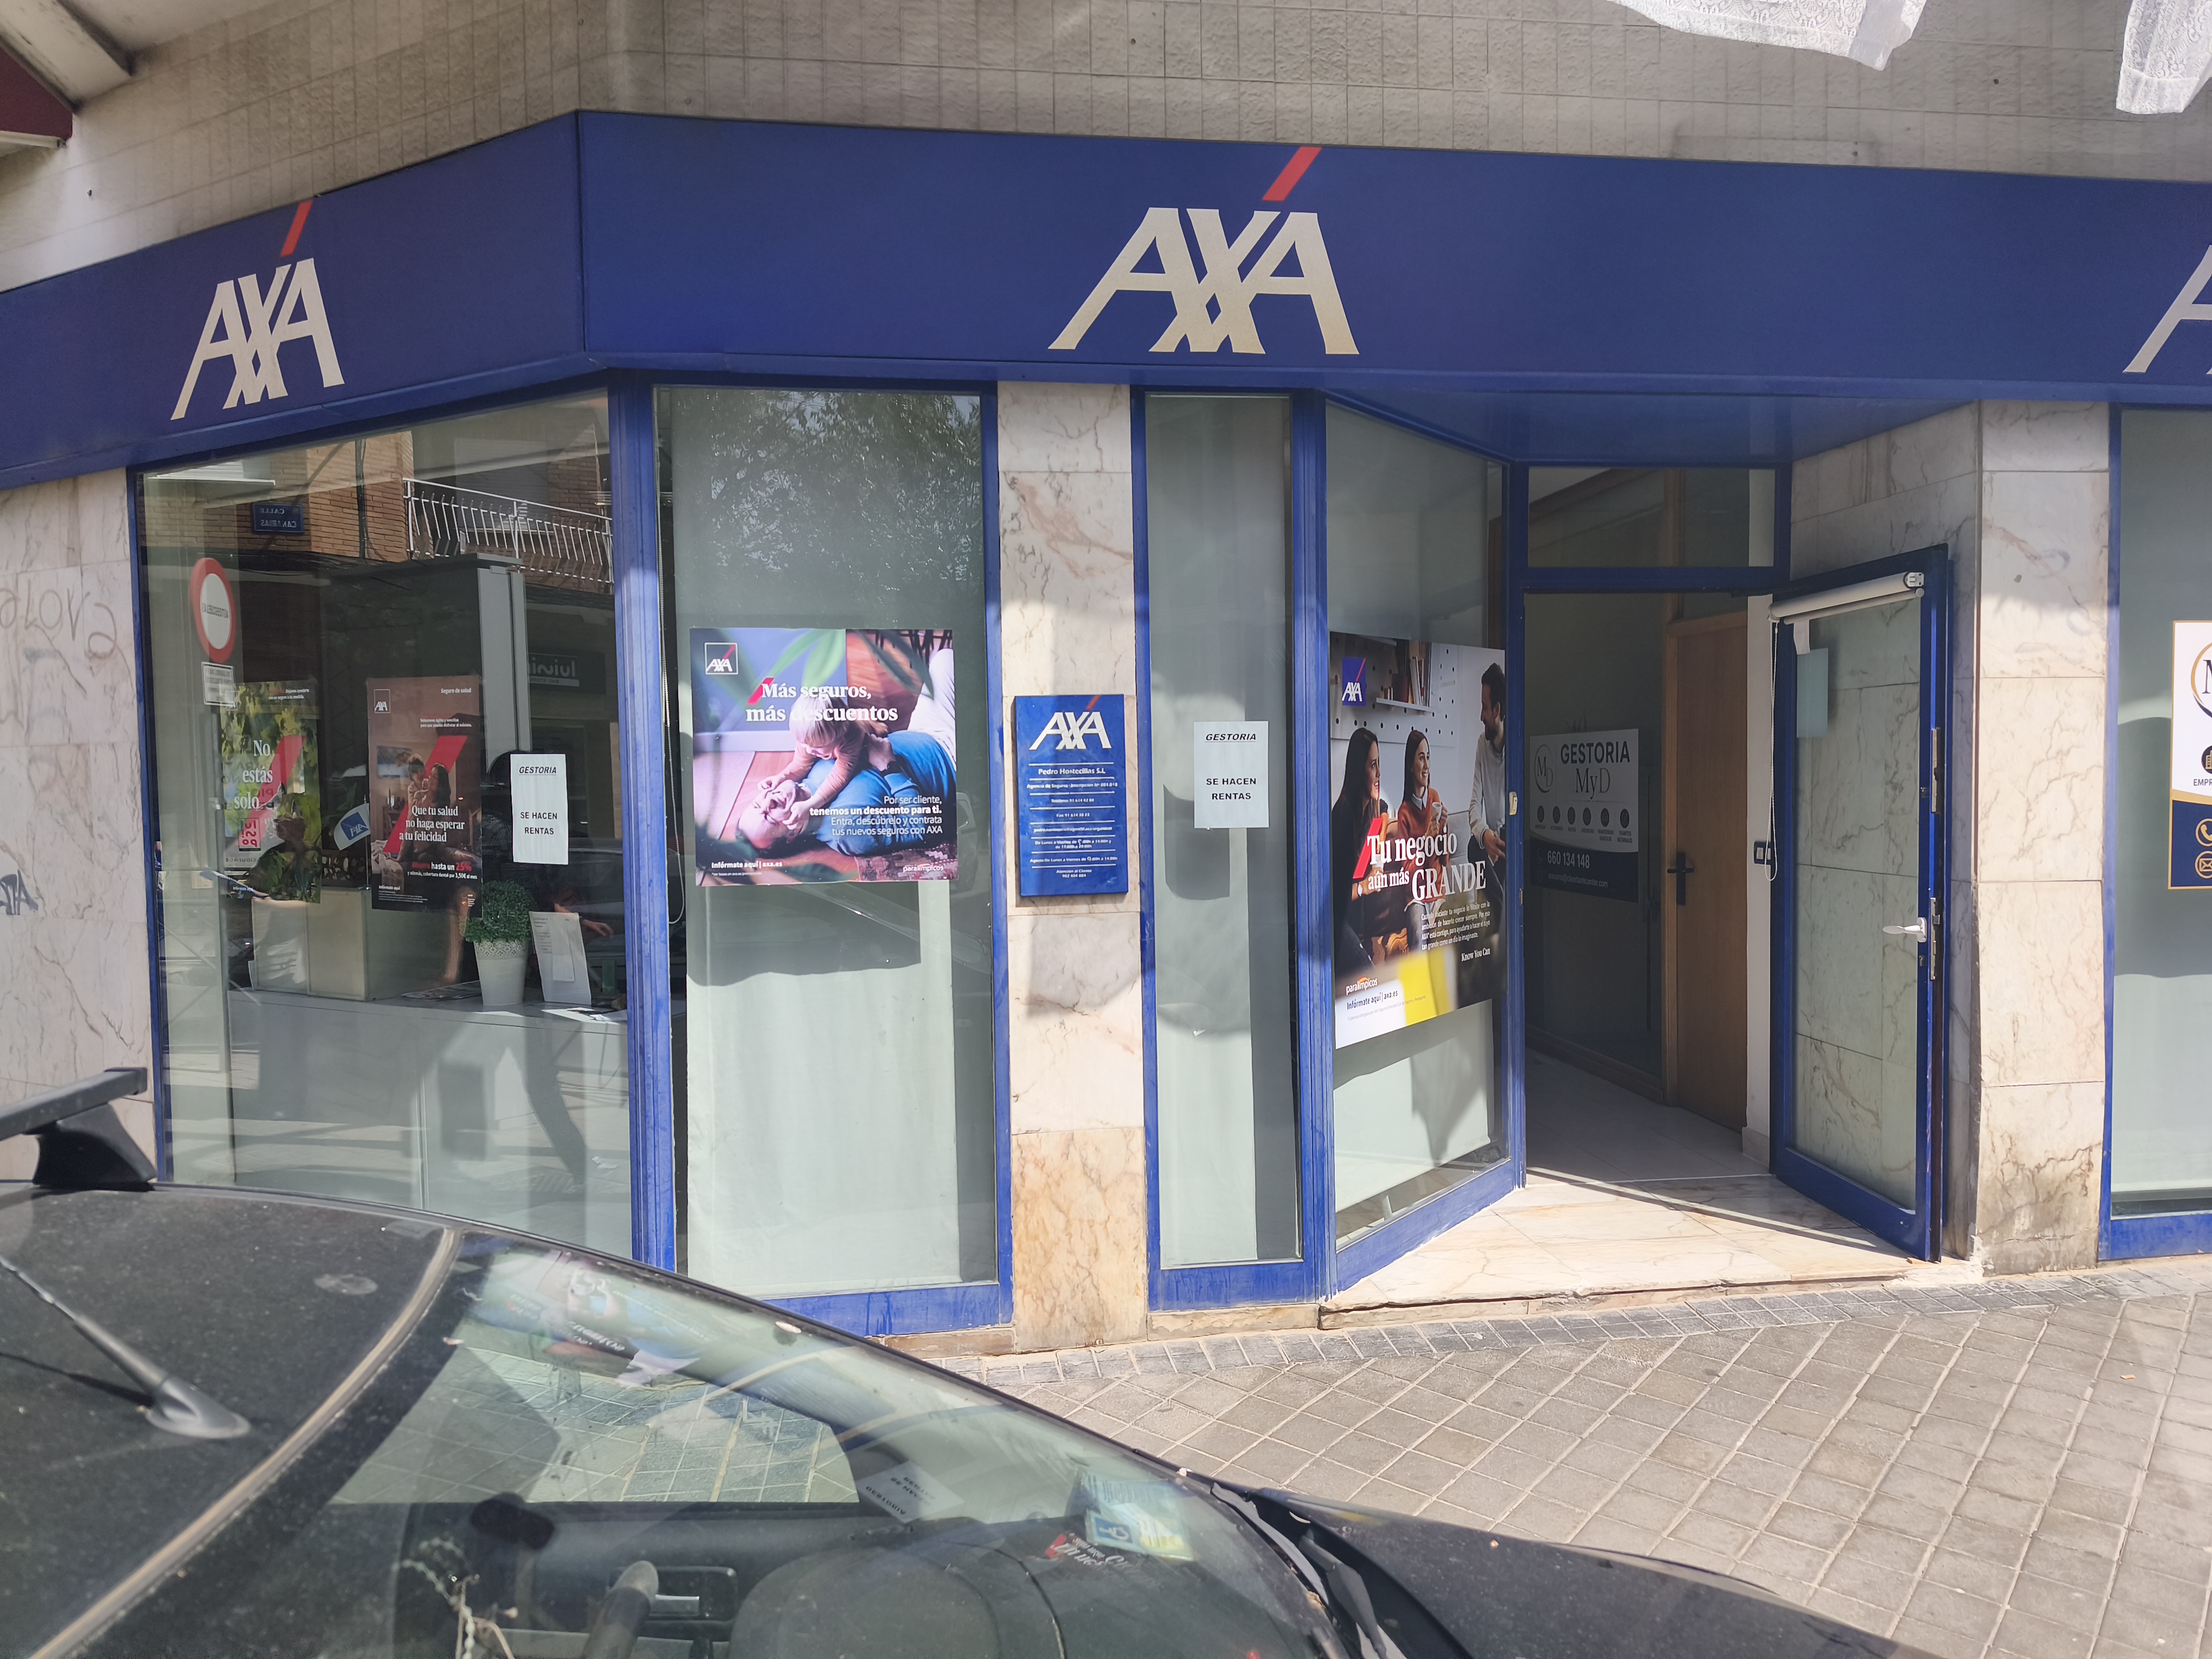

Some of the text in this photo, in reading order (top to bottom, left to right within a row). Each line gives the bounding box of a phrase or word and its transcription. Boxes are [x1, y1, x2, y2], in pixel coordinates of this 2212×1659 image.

[1047, 207, 1360, 355] AXA
[170, 258, 345, 420] AXA
[706, 658, 732, 672] AXA
[761, 683, 872, 700] Más seguros,
[1342, 681, 1362, 702] AXA
[374, 701, 388, 711] AXA
[746, 704, 898, 722] más descuentos
[1029, 711, 1112, 750] AXA
[253, 740, 271, 756] No
[1560, 741, 1630, 764] GESTORIA
[242, 766, 273, 783] estás
[1576, 767, 1611, 799] MyD
[234, 792, 260, 809] solo
[884, 796, 898, 805] Por
[914, 795, 942, 805] cliente,
[411, 805, 458, 817] Que tu salud
[809, 807, 850, 816] tenemos
[864, 806, 910, 815] descuento
[911, 806, 931, 816] para
[932, 805, 942, 814] ti.
[406, 818, 465, 831] no haga esperar
[831, 815, 942, 827] Entra, descúbrelo y contrata
[350, 823, 369, 837] AXA
[404, 832, 413, 840] tu
[414, 831, 447, 842] felicidad
[832, 828, 845, 836] tus
[877, 827, 909, 837] seguros
[910, 826, 925, 834] con
[926, 825, 943, 834] AXA
[1367, 826, 1457, 866] Tu negocio
[431, 861, 446, 870] hasta
[456, 861, 472, 871] 25%
[744, 860, 759, 869] aquí
[1547, 850, 1590, 869] 660 134 148
[1368, 860, 1486, 901] aún más GRANDE
[1454, 906, 1465, 915] negocio
[1422, 922, 1437, 930] ambición
[1443, 917, 1454, 925] hacerlo
[1465, 913, 1478, 922] siempre.
[1437, 928, 1449, 937] contigo,
[1457, 924, 1469, 933] ayudarte
[1428, 940, 1439, 950] grande
[1462, 932, 1478, 941] imaginaste.
[1461, 952, 1474, 962] Know
[1347, 991, 1398, 1010] Infórmate aquí axa.es
